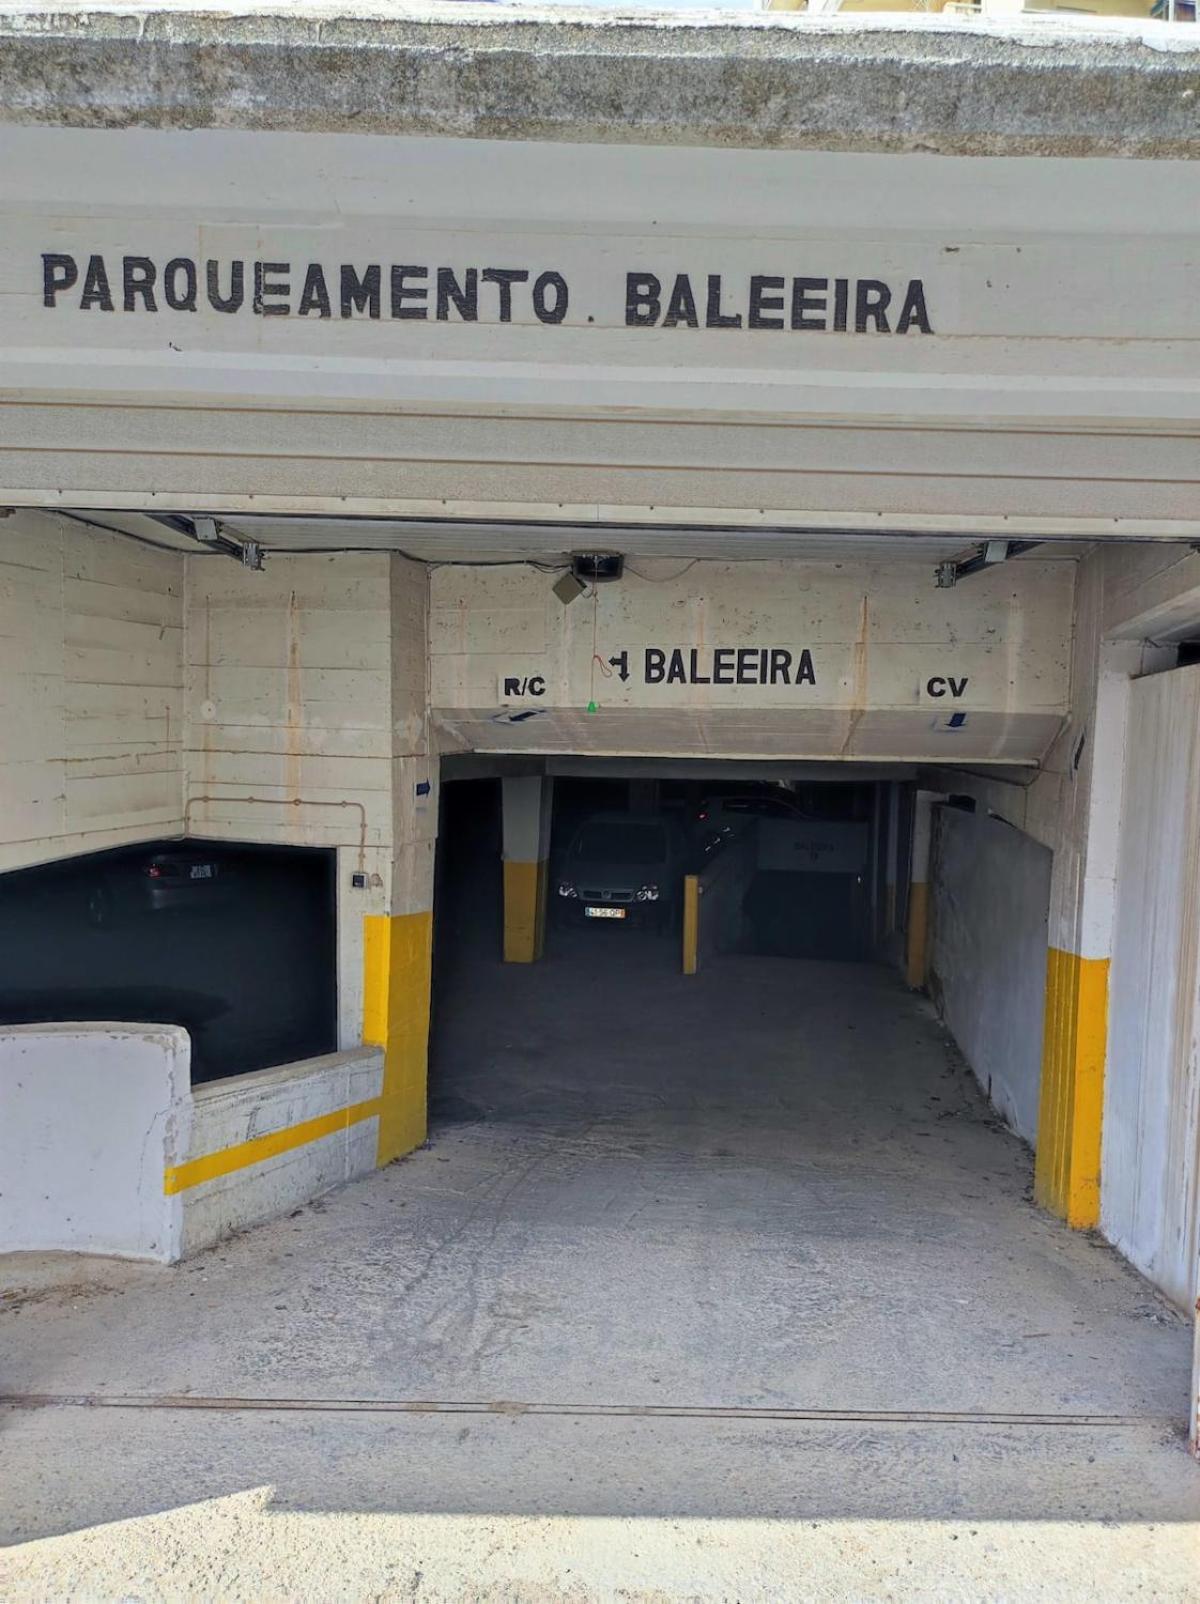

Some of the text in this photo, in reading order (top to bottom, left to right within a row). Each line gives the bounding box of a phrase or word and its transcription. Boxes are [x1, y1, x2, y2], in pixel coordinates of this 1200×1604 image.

[41, 254, 934, 334] PARQUEAMENTO BALEEIRA
[645, 648, 816, 685] BALEEIRA
[504, 677, 546, 697] R/C
[927, 677, 969, 697] CV
